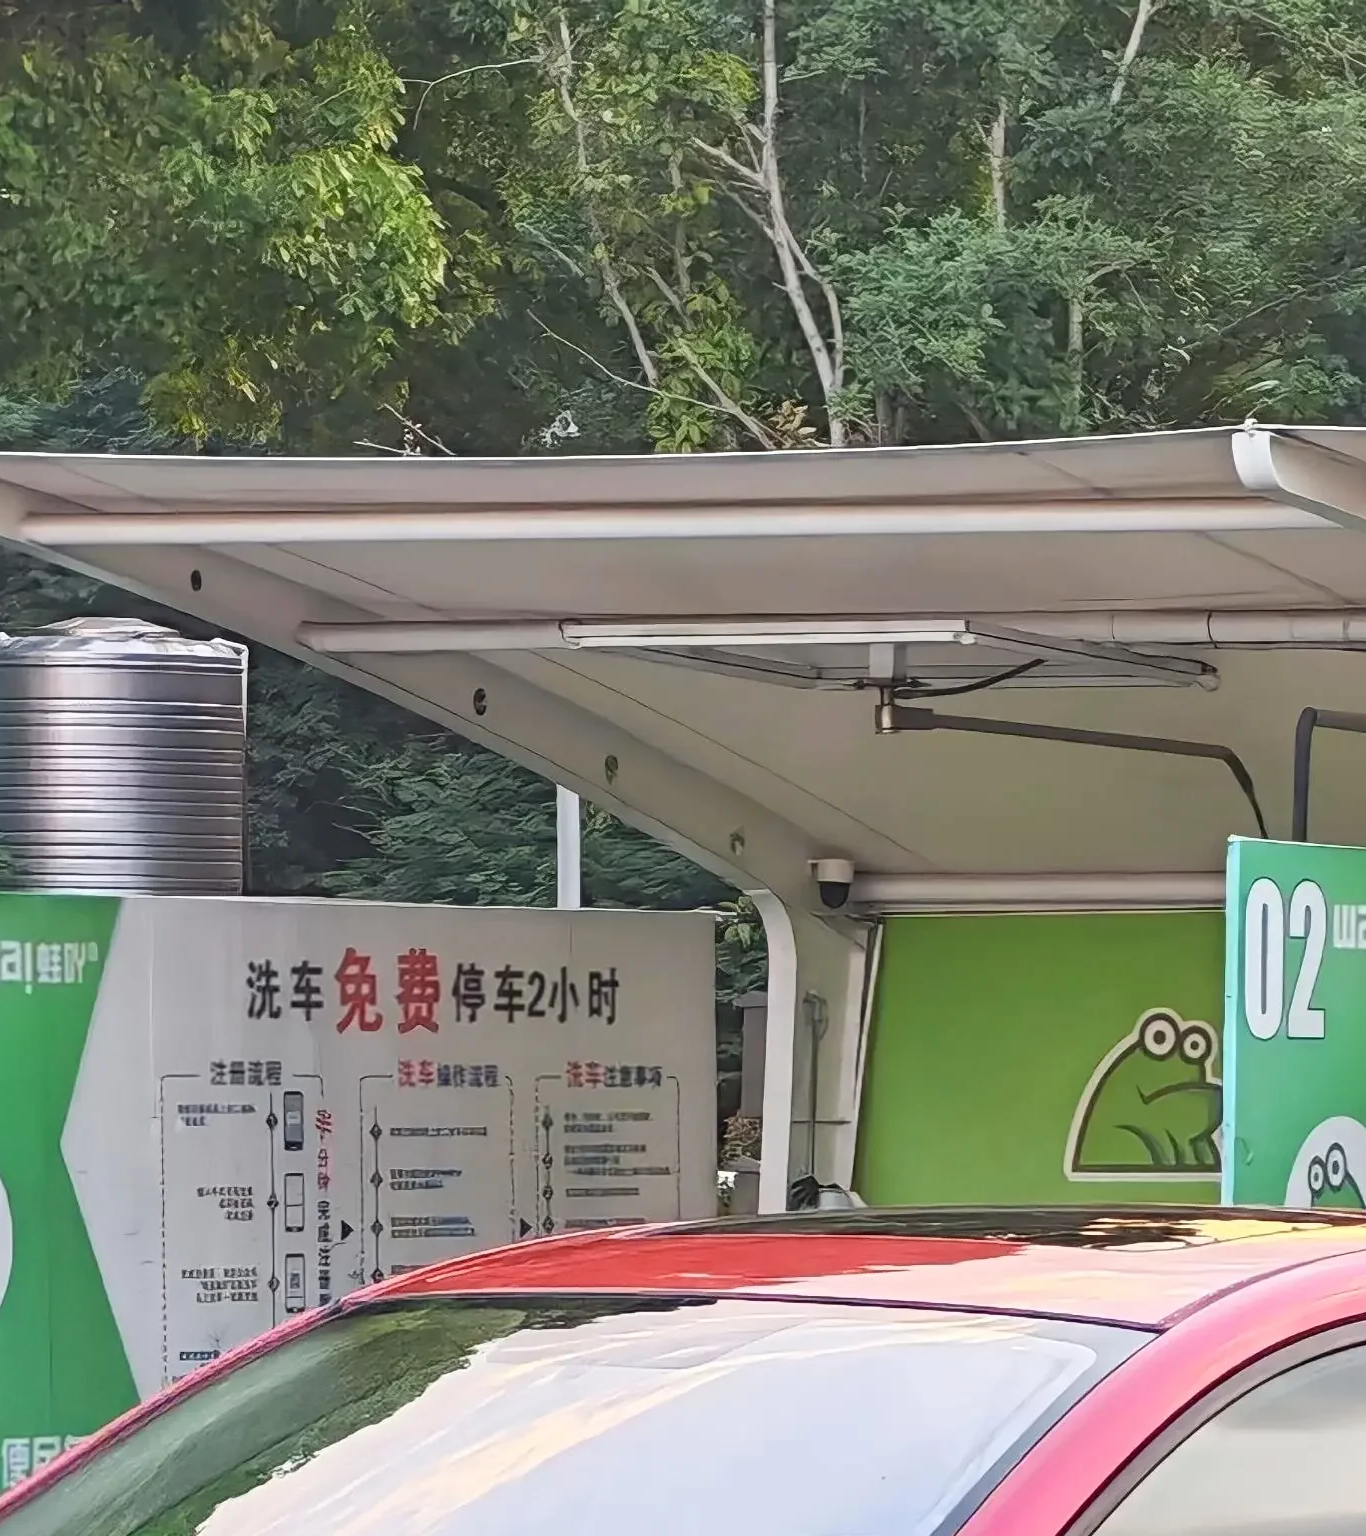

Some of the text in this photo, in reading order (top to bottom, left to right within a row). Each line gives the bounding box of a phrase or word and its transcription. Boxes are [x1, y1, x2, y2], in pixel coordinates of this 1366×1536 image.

[246, 947, 620, 1034] 洗车免费停车2小时
[1245, 877, 1327, 1040] 02
